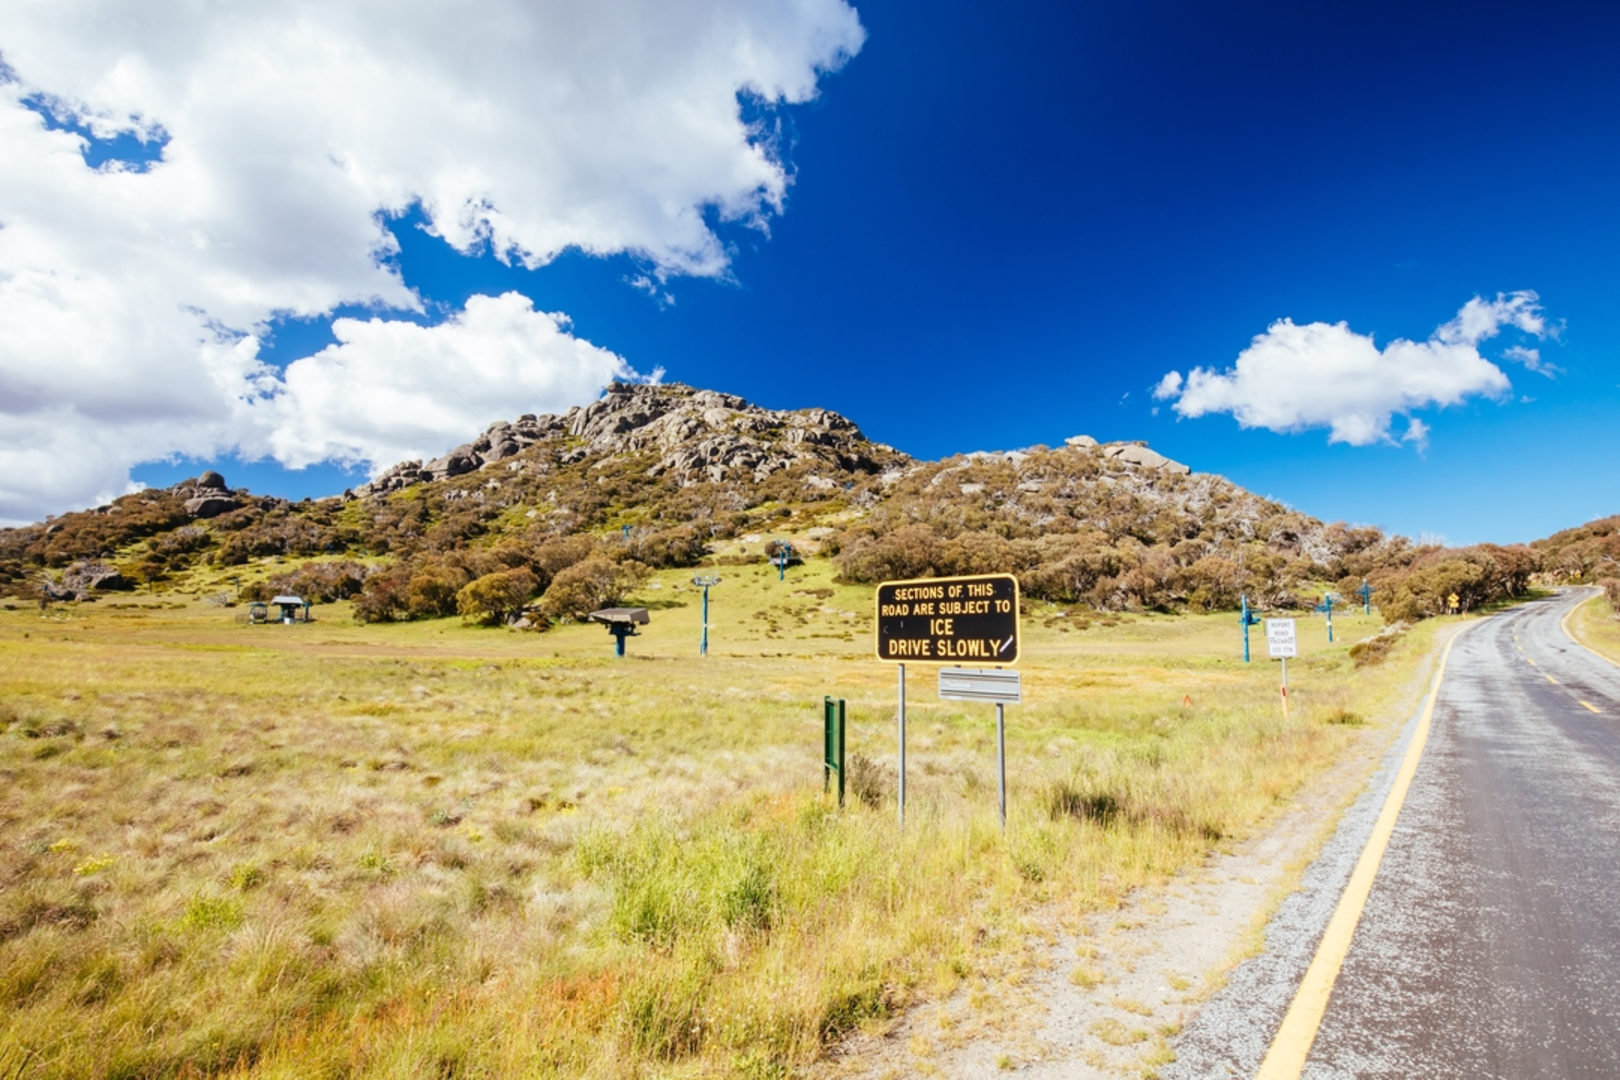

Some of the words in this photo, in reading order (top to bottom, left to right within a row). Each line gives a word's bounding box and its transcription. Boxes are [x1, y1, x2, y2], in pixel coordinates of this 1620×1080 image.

[894, 586, 944, 601] SECTIONS
[948, 585, 963, 598] OF
[967, 583, 994, 597] THIS
[881, 604, 909, 616] ROAD
[913, 603, 935, 615] ARE
[938, 601, 990, 615] SUBJECT
[994, 600, 1011, 613] TO
[930, 618, 954, 635] ICE
[888, 639, 931, 655] DRIVE
[936, 639, 1001, 657] SLOWLY
